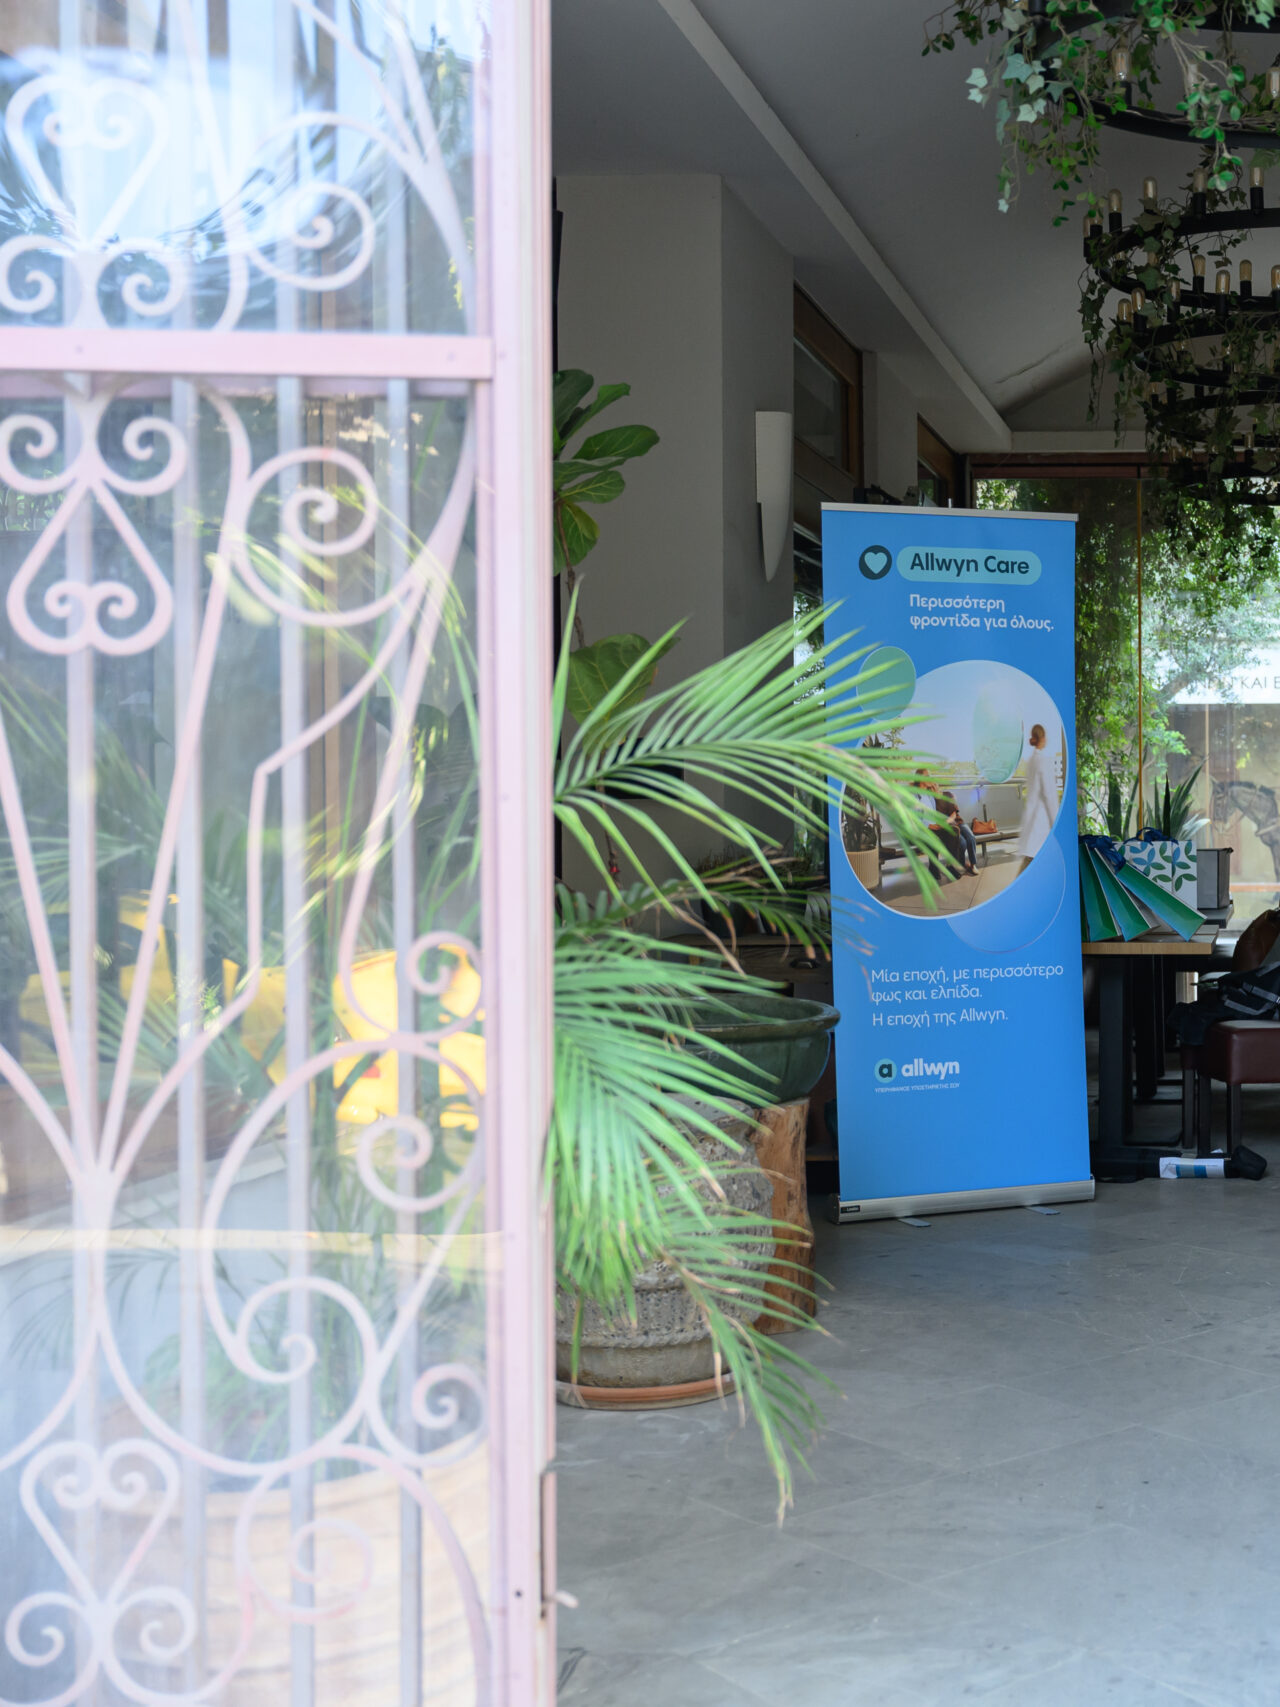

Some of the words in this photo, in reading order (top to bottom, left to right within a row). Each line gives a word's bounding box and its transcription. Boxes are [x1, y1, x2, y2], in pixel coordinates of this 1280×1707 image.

[909, 552, 979, 577] Allwyn
[984, 555, 1030, 575] Care
[909, 593, 1006, 613] Περισσότερη
[909, 613, 980, 630] φροντίδα
[983, 617, 1007, 631] για
[1010, 615, 1055, 632] όλους.
[1240, 676, 1267, 689] ΚΑΙ
[871, 969, 899, 983] Μία
[903, 966, 950, 985] εποχή,
[953, 968, 970, 983] με
[973, 963, 1064, 982] περισσότερο
[871, 990, 902, 1006] φως
[905, 988, 927, 1001] και
[930, 984, 983, 1000] ελπίδα.
[872, 1012, 883, 1026] Η
[887, 1010, 930, 1028] εποχή
[933, 1011, 957, 1027] της
[959, 1007, 1009, 1025] Allwyn.
[901, 1057, 960, 1080] allwyn
